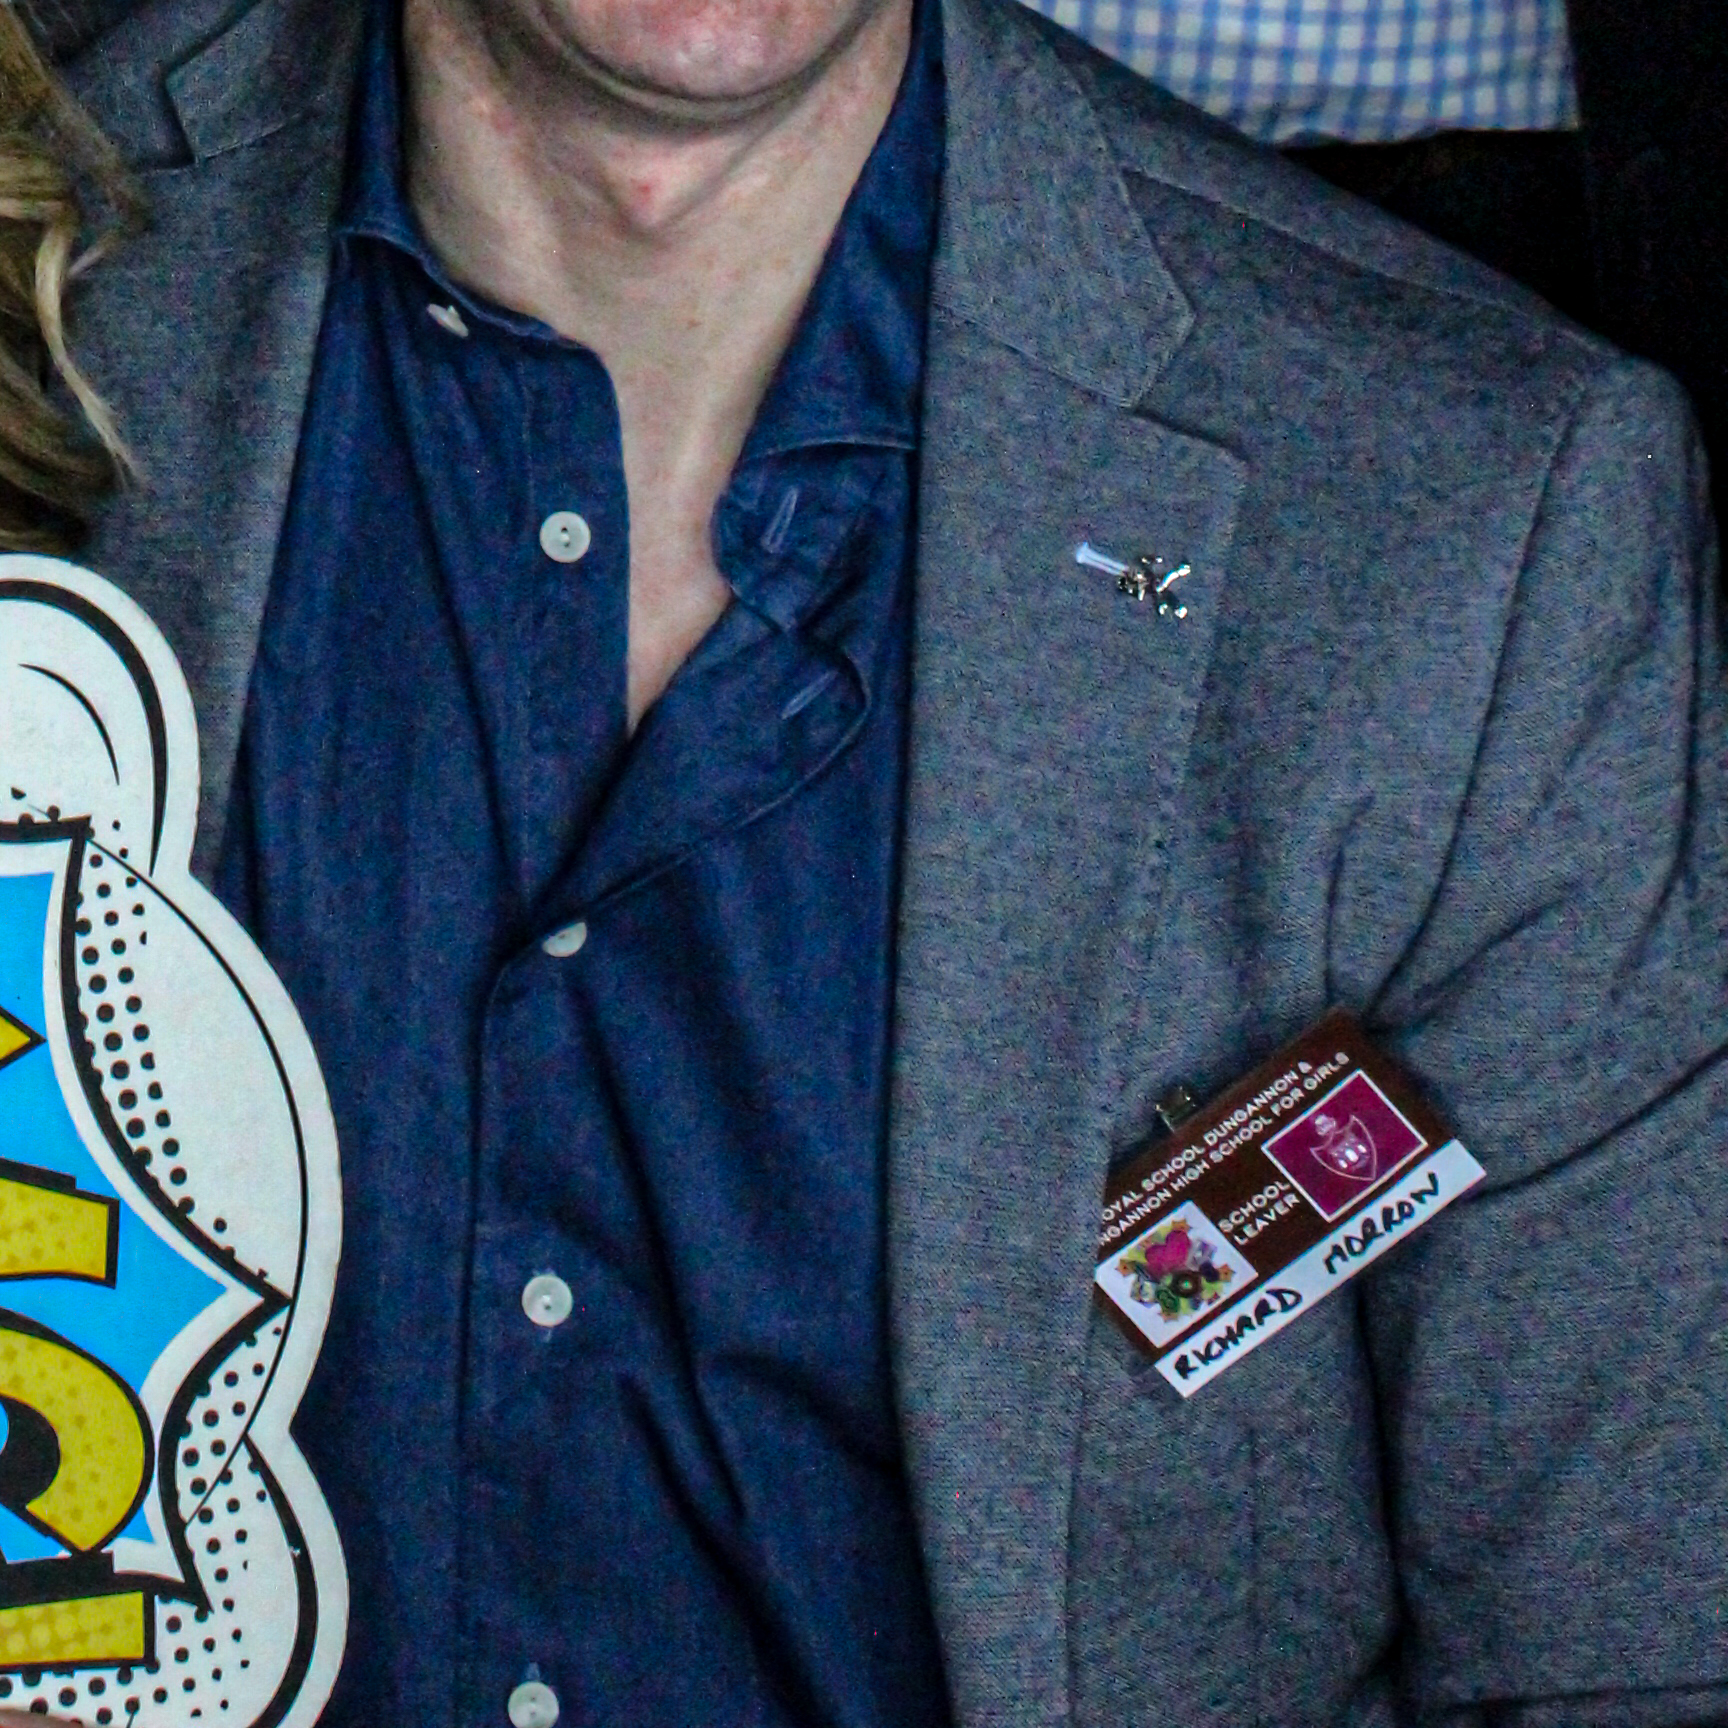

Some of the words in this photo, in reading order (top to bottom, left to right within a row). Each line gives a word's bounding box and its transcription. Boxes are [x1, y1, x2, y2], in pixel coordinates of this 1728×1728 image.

[1098, 1187, 1173, 1246] NGANNON
[1169, 1159, 1211, 1192] HIGH
[1209, 1113, 1272, 1164] SCHOOL
[1271, 1086, 1306, 1118] FOR
[1302, 1051, 1351, 1094] GIRLS
[1101, 1190, 1144, 1224] OYAL
[1141, 1143, 1206, 1192] SCHOOL
[1203, 1068, 1300, 1146] DUNGANNON
[1218, 1177, 1291, 1234] SCHOOL
[1234, 1192, 1301, 1246] LEAVER
[1173, 1287, 1304, 1381] RICHARD
[1322, 1171, 1442, 1276] MORROW
